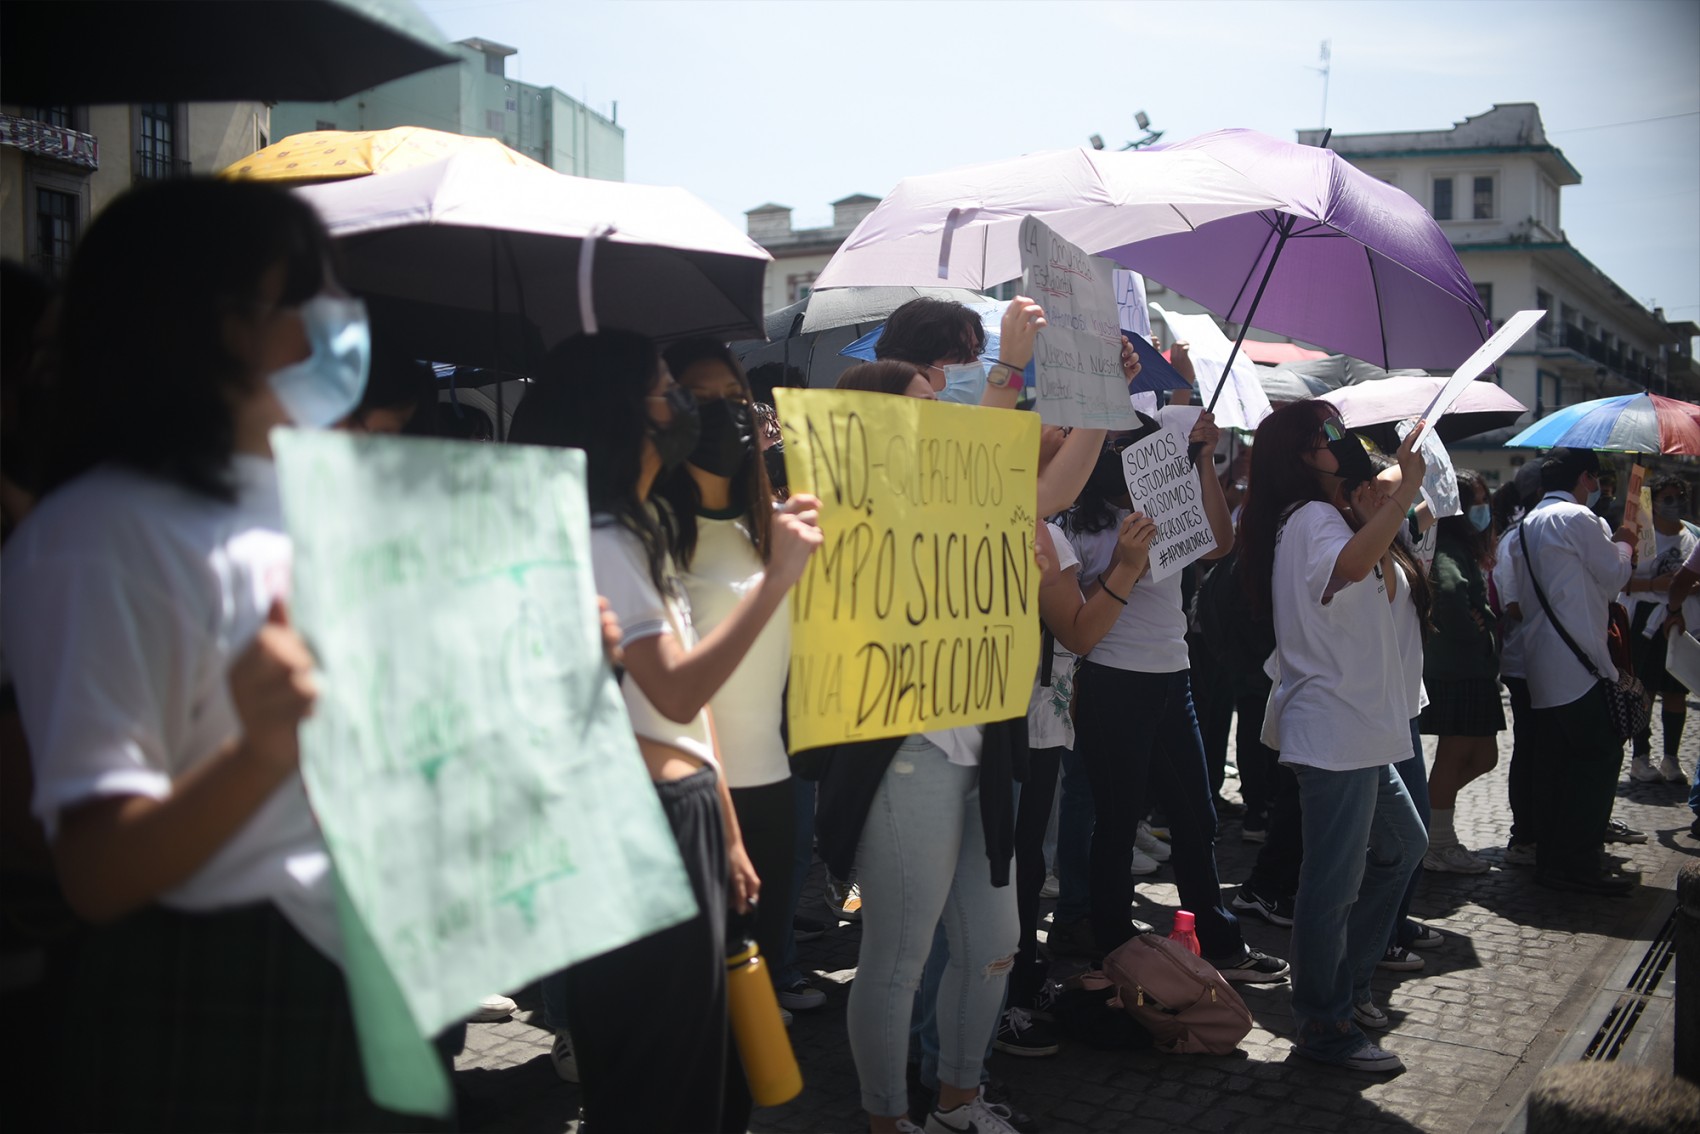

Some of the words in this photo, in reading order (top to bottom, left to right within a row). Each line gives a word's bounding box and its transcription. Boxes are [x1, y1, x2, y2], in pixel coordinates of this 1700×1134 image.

[1117, 270, 1137, 307] LA
[1126, 433, 1177, 476] SOMOS
[1130, 455, 1192, 501] ESTUDIANTES
[1143, 496, 1159, 518] NO
[1157, 480, 1195, 514] SOMOS
[855, 626, 1010, 728] DIRECCIÓN
